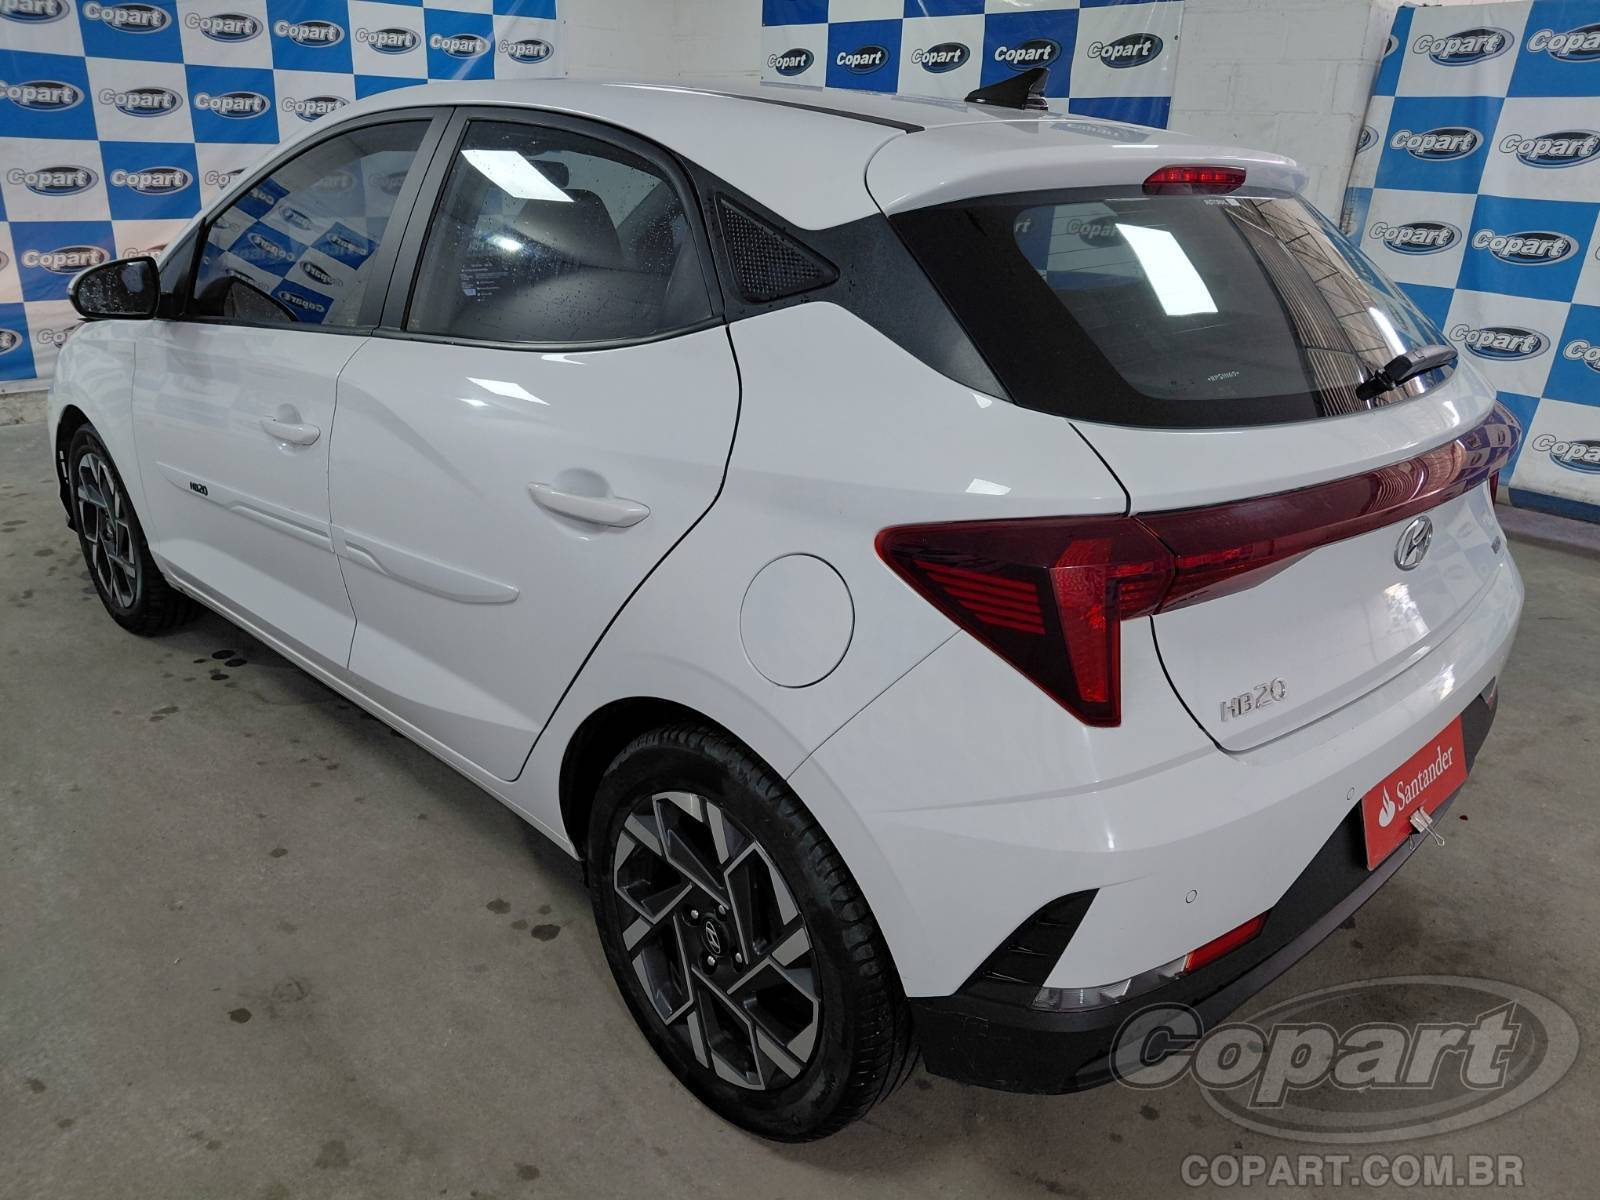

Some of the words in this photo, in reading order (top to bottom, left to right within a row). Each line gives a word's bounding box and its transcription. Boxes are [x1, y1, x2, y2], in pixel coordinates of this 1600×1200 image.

[0, 0, 57, 16] part
[84, 3, 163, 28] Copart
[186, 13, 253, 36] Copart
[275, 20, 336, 41] Copart
[356, 28, 413, 47] Copart
[430, 34, 483, 53] Copart
[499, 40, 547, 57] Copart
[1413, 34, 1499, 57] Copart
[1528, 28, 1600, 57] Copa
[768, 51, 808, 76] Copart
[837, 50, 881, 73] Copart
[911, 47, 960, 73] Copart
[995, 44, 1050, 69] Copart
[1088, 39, 1151, 66] Copart
[99, 88, 172, 110] Copart
[194, 93, 262, 112] Copart
[1391, 130, 1473, 154] Copart
[1500, 134, 1598, 159] Copart
[7, 168, 87, 189] Copart
[110, 169, 183, 189] Copart
[1370, 222, 1450, 246] Copart
[1473, 229, 1564, 258] Copart
[21, 249, 101, 272] Copart
[1450, 324, 1538, 353] Copart
[1532, 433, 1600, 463] Copa
[189, 481, 208, 496] HB20
[1219, 677, 1288, 723] HB20
[1396, 745, 1453, 812] Santander
